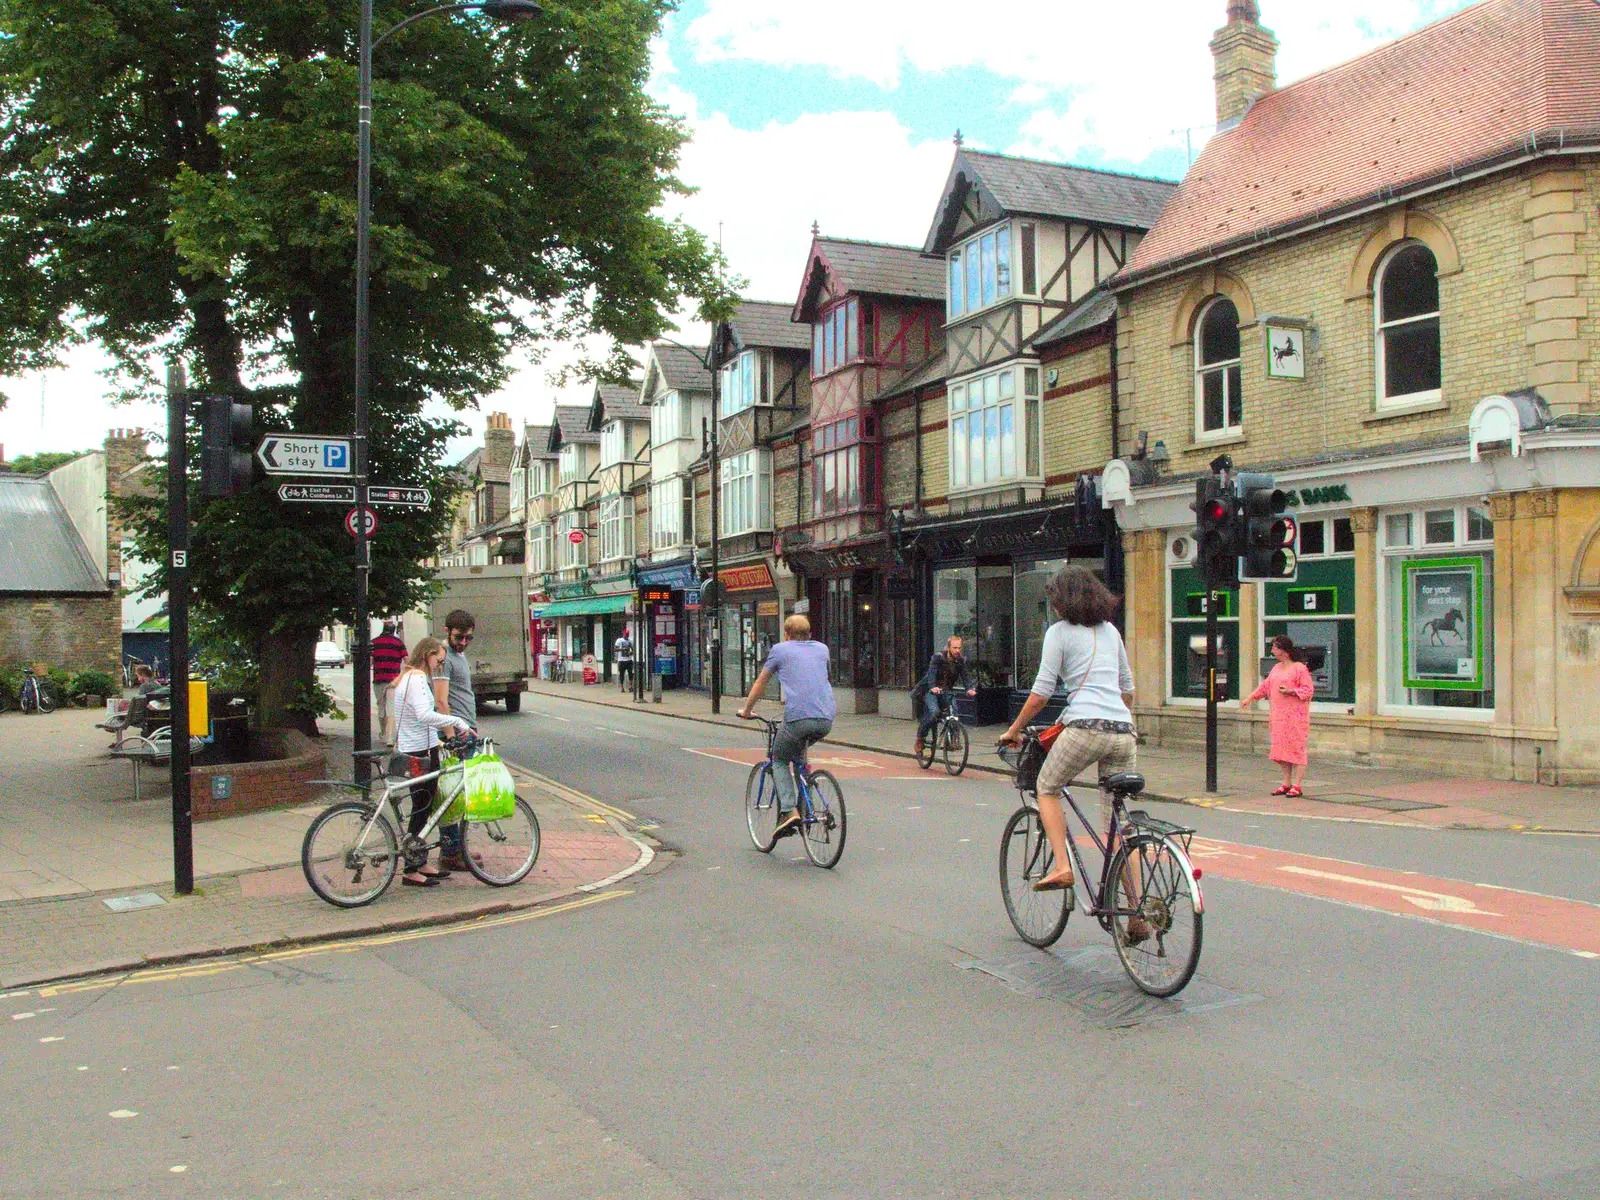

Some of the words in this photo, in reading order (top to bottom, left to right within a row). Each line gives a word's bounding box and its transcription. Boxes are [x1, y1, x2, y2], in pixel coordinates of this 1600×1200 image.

[284, 443, 319, 454] Short
[288, 457, 316, 469] stay
[327, 446, 341, 467] P
[1299, 484, 1351, 505] BANK
[174, 552, 185, 566] 5
[1422, 585, 1433, 594] for
[1433, 586, 1452, 595] your
